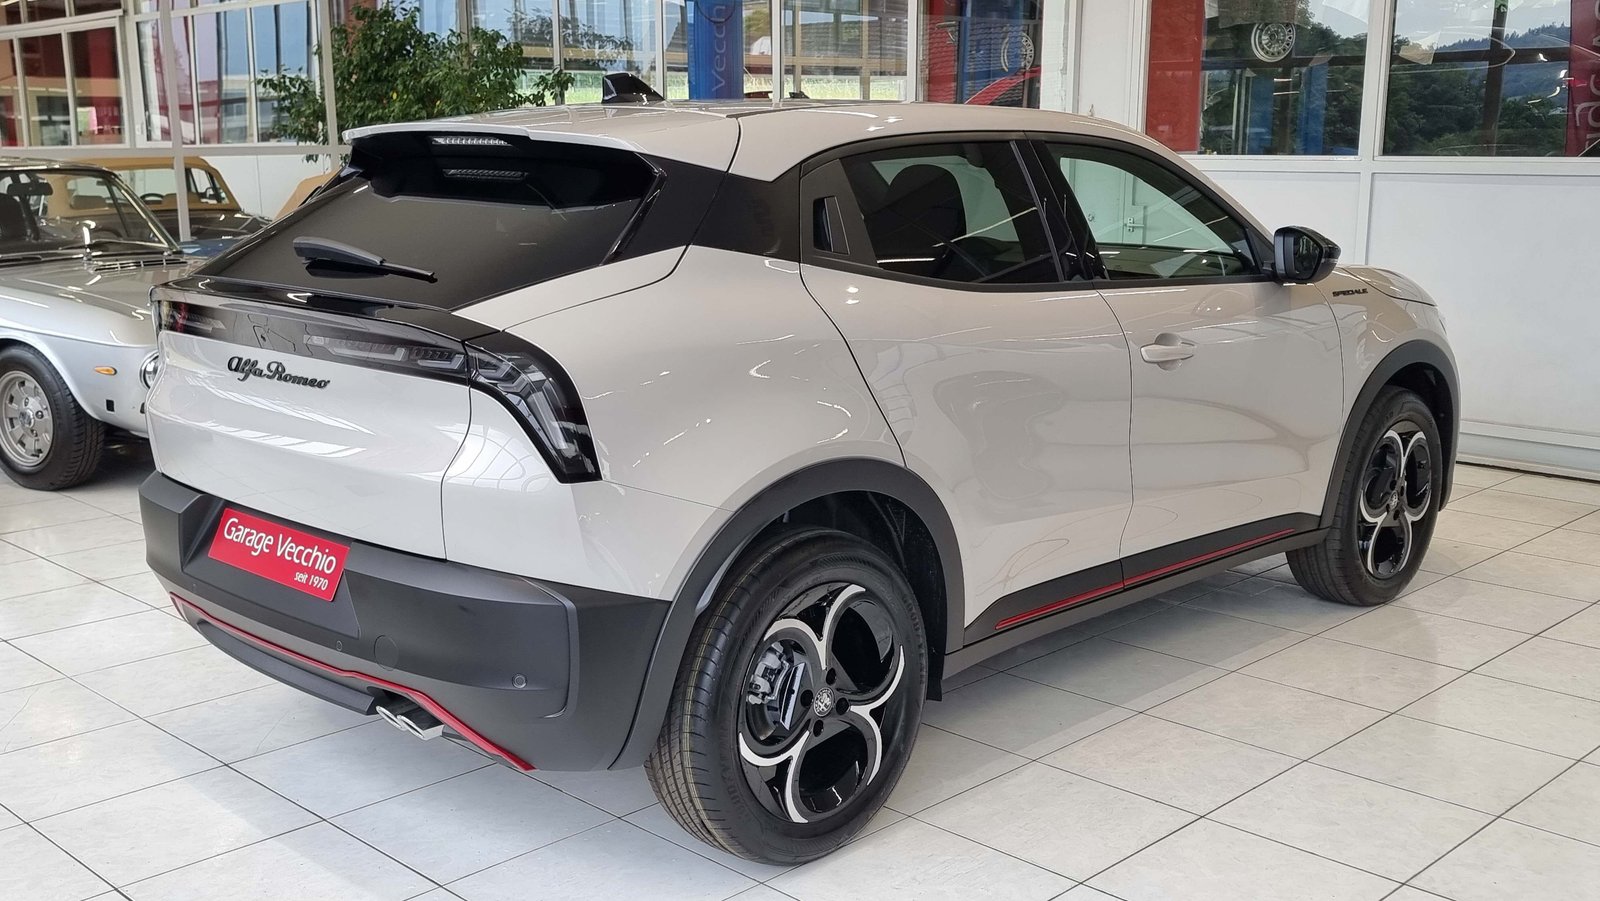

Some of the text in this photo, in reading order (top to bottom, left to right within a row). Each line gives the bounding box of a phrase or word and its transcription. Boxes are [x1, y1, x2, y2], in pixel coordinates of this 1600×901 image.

[227, 356, 331, 389] Alfa Romeo
[223, 517, 337, 575] Garage Vecchio
[293, 571, 329, 591] seit 1970
